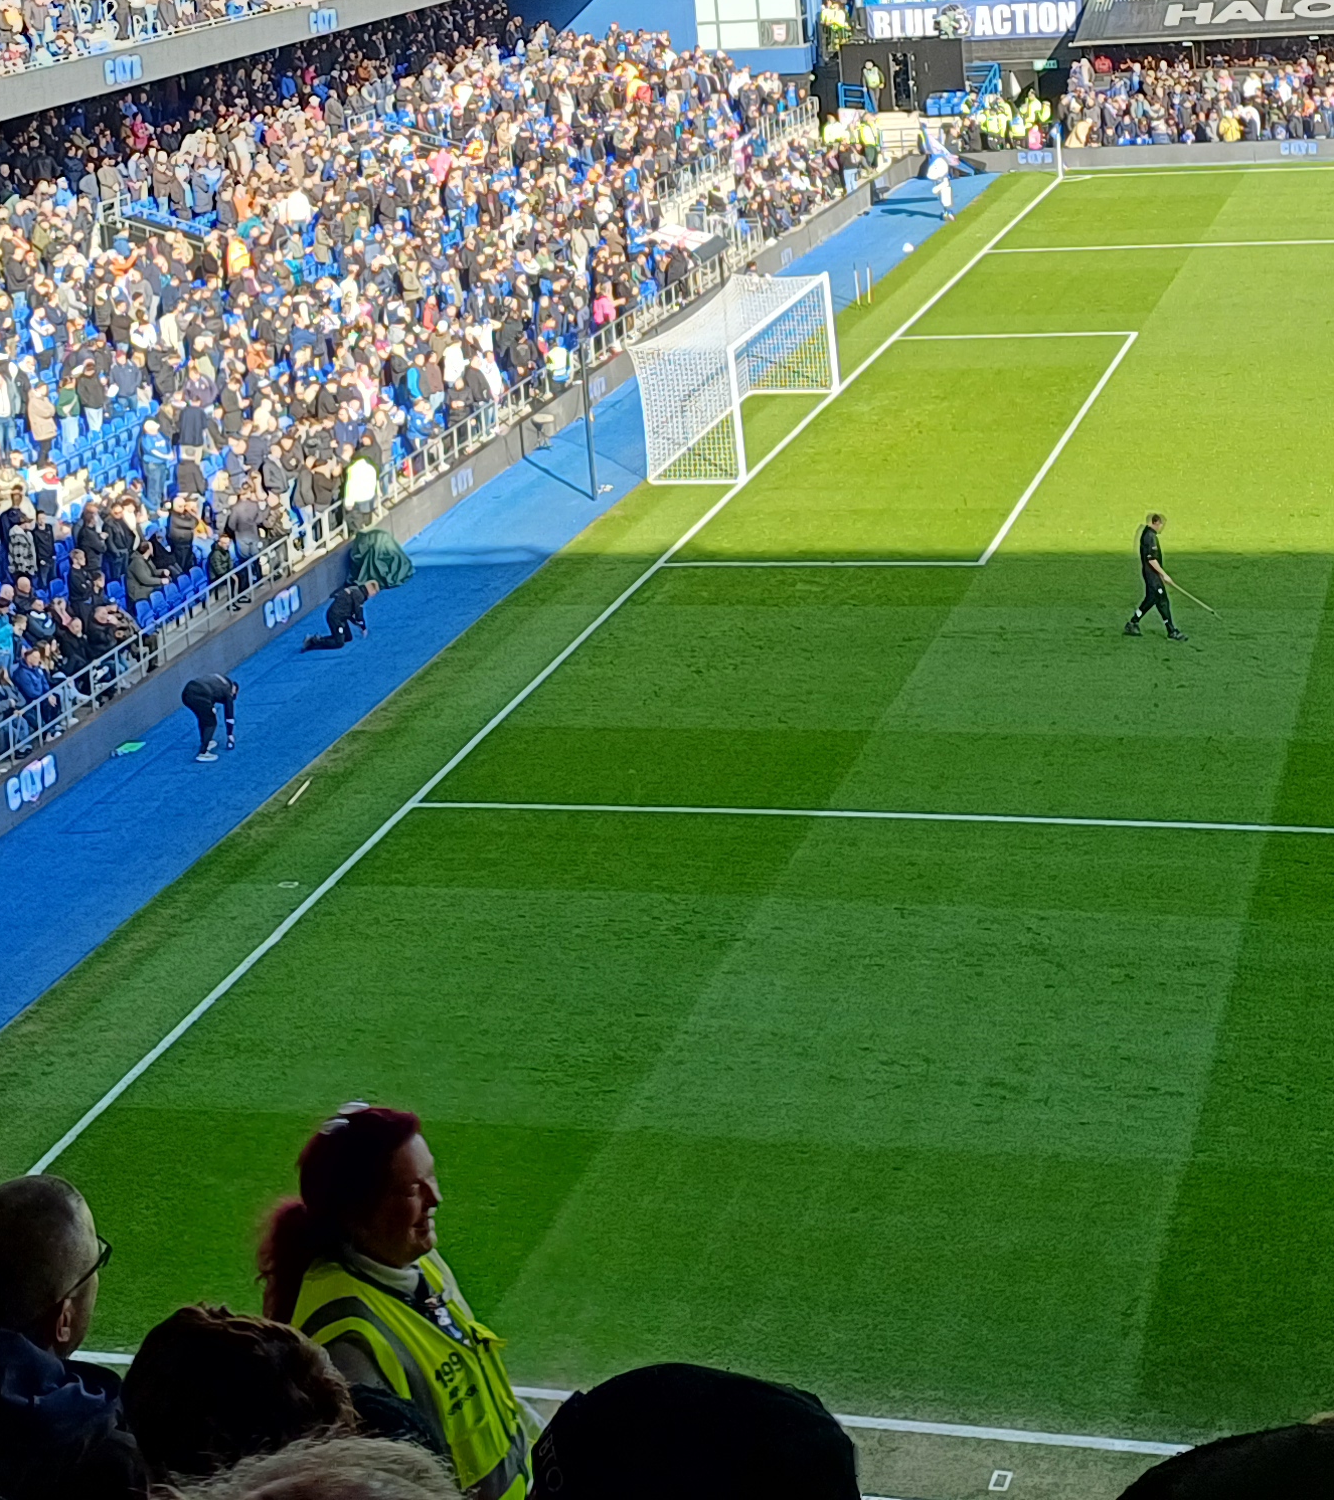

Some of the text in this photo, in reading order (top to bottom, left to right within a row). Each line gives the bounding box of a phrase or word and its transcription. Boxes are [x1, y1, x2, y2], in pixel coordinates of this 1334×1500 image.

[871, 0, 1076, 39] BLUE ACTION
[435, 1351, 464, 1388] 199
